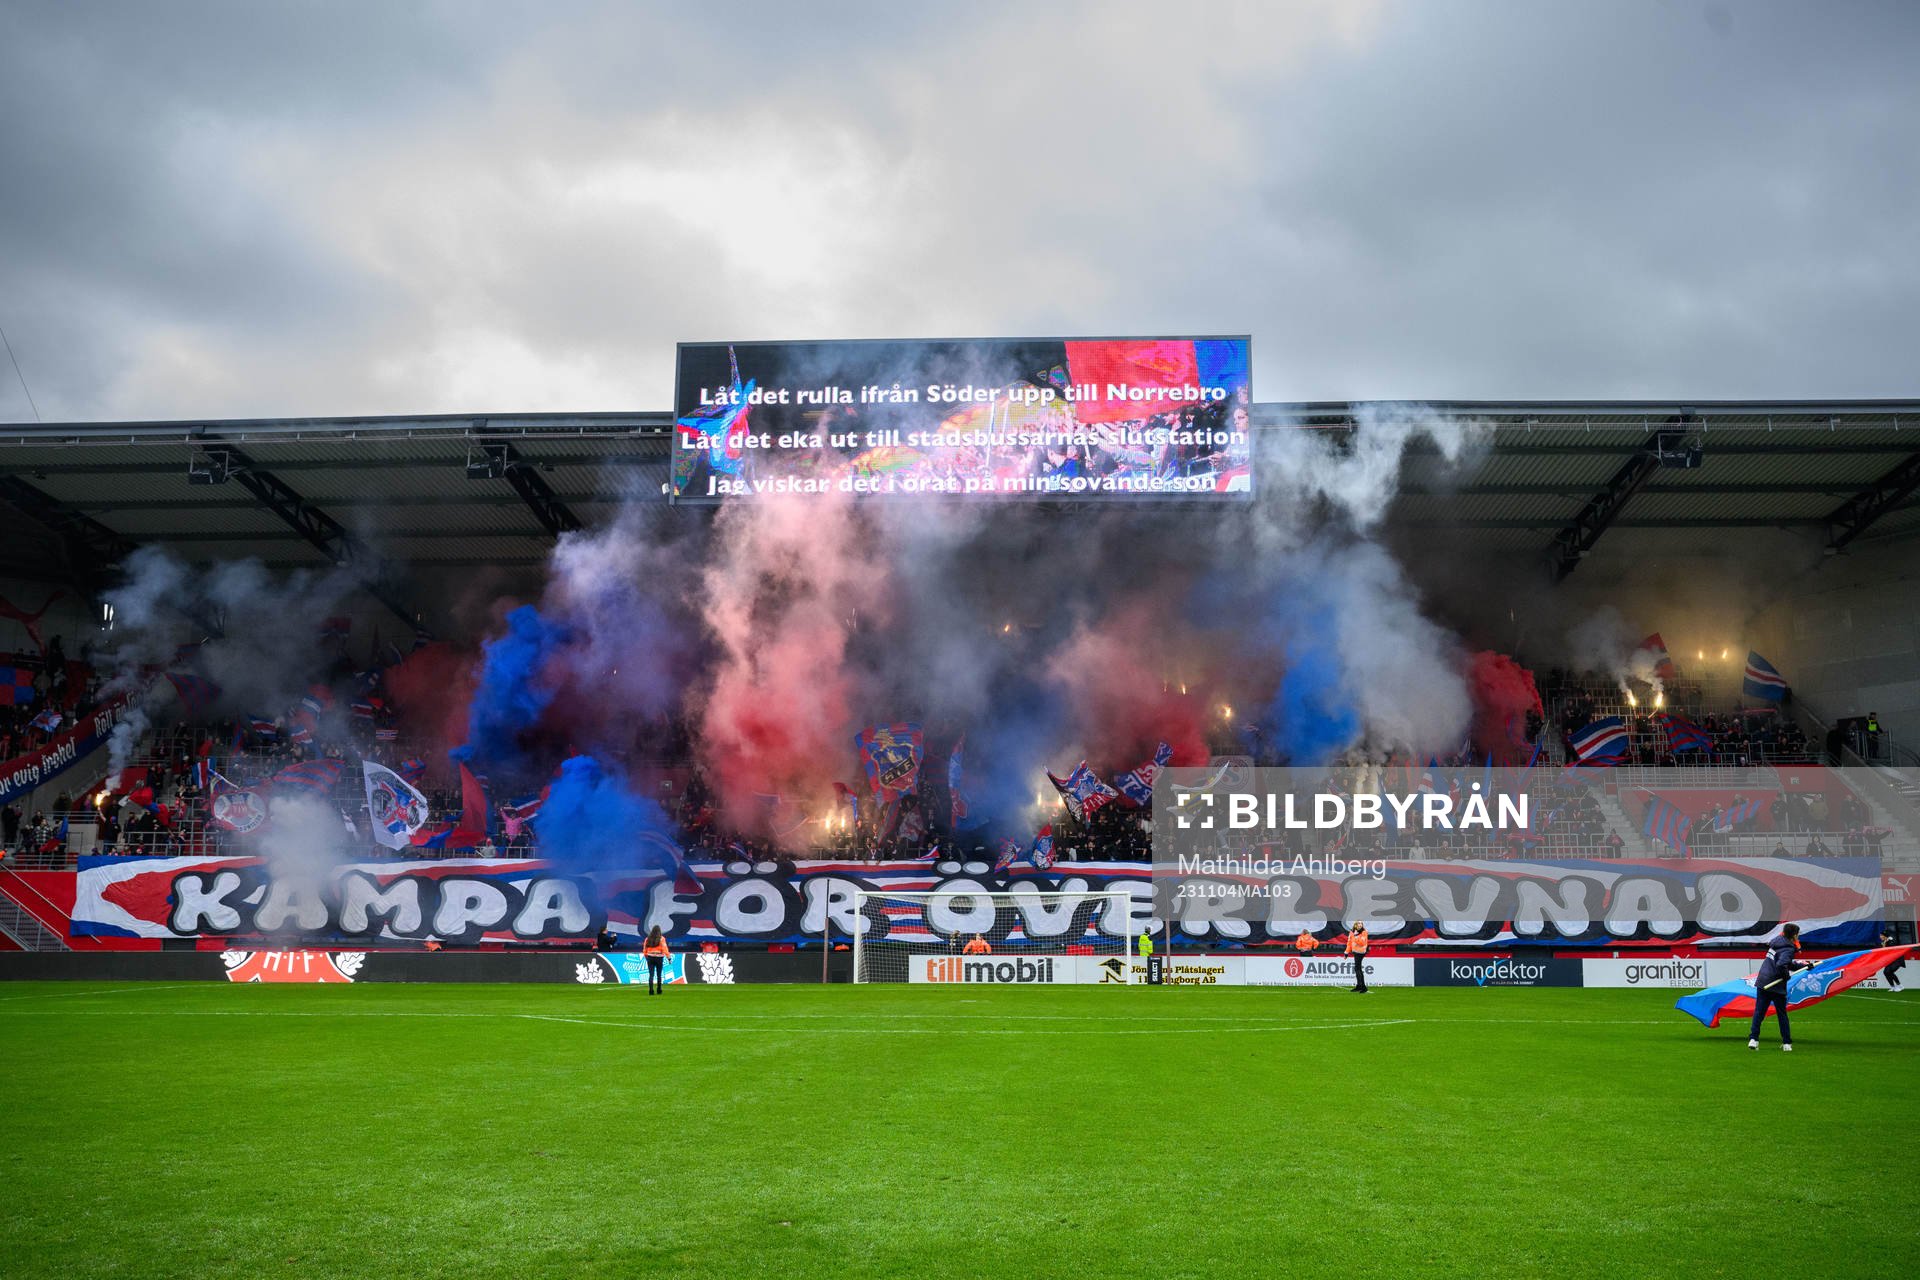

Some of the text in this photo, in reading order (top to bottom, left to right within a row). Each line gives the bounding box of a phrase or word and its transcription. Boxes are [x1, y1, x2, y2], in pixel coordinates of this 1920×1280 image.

[700, 383, 1227, 406] Låt det rulla ifrån Söder upp till Norrebro
[682, 427, 1244, 449] Låt det eka ut till stadsbussarnas slutstation
[706, 475, 745, 495] Jag
[753, 475, 830, 493] viskar
[838, 475, 880, 493] det
[903, 474, 957, 492] örat
[965, 473, 995, 493] på
[1003, 473, 1050, 491] min
[1060, 472, 1164, 491] sovande
[1173, 476, 1217, 491] son
[13, 763, 40, 785] evig
[647, 860, 872, 936] FÖR
[926, 860, 1764, 938] ÖVERLEVNAD
[926, 957, 1053, 983] tillmobil
[1130, 965, 1225, 975] Jönns Plåtslageri
[1305, 961, 1374, 975] AllOffie
[1450, 960, 1547, 979] kondektor
[1625, 960, 1702, 984] granitor
[1144, 975, 1200, 985] singborg
[1201, 976, 1217, 984] AB
[1669, 979, 1704, 987] ELECTRO
